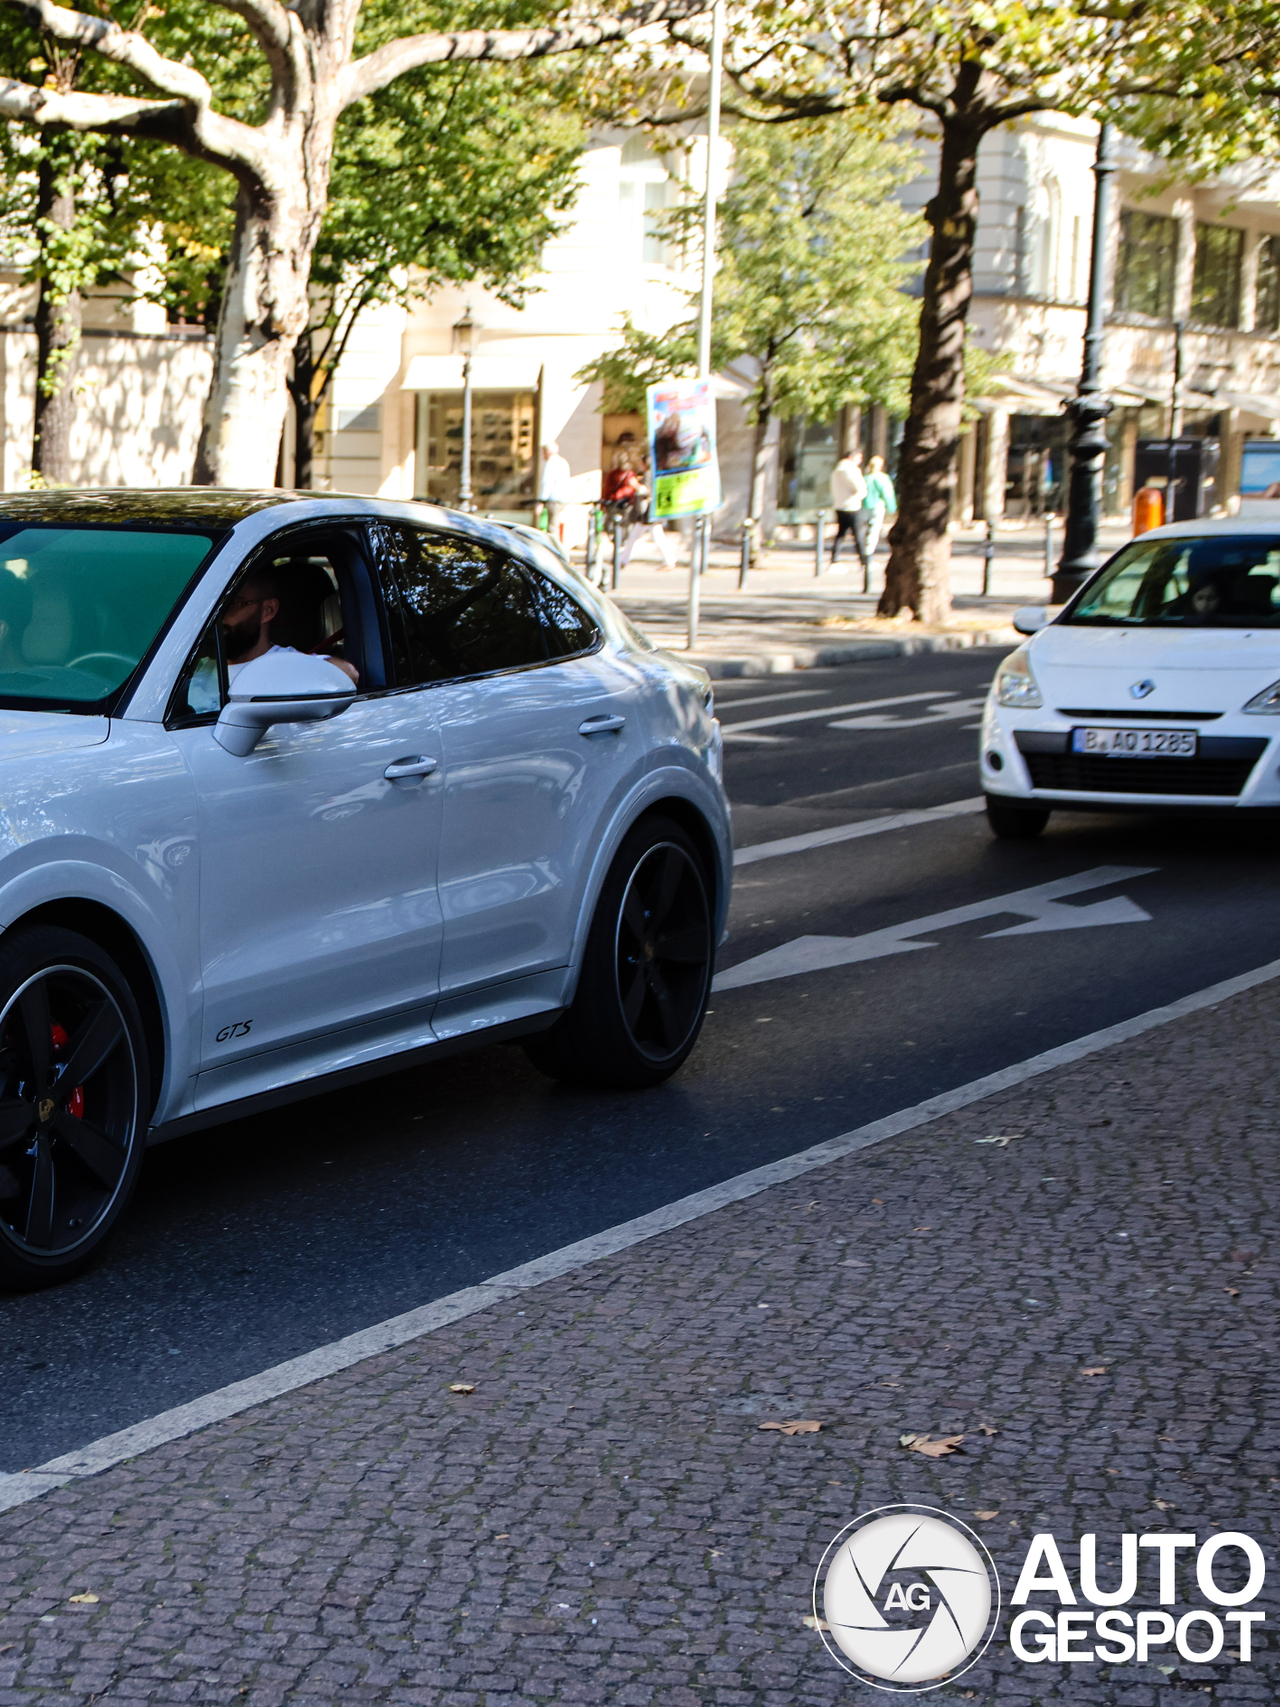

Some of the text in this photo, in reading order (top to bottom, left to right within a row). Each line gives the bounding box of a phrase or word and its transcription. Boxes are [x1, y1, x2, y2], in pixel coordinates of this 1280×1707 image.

[1086, 731, 1097, 750] B
[1141, 733, 1193, 753] 1285
[215, 1019, 254, 1042] GTS
